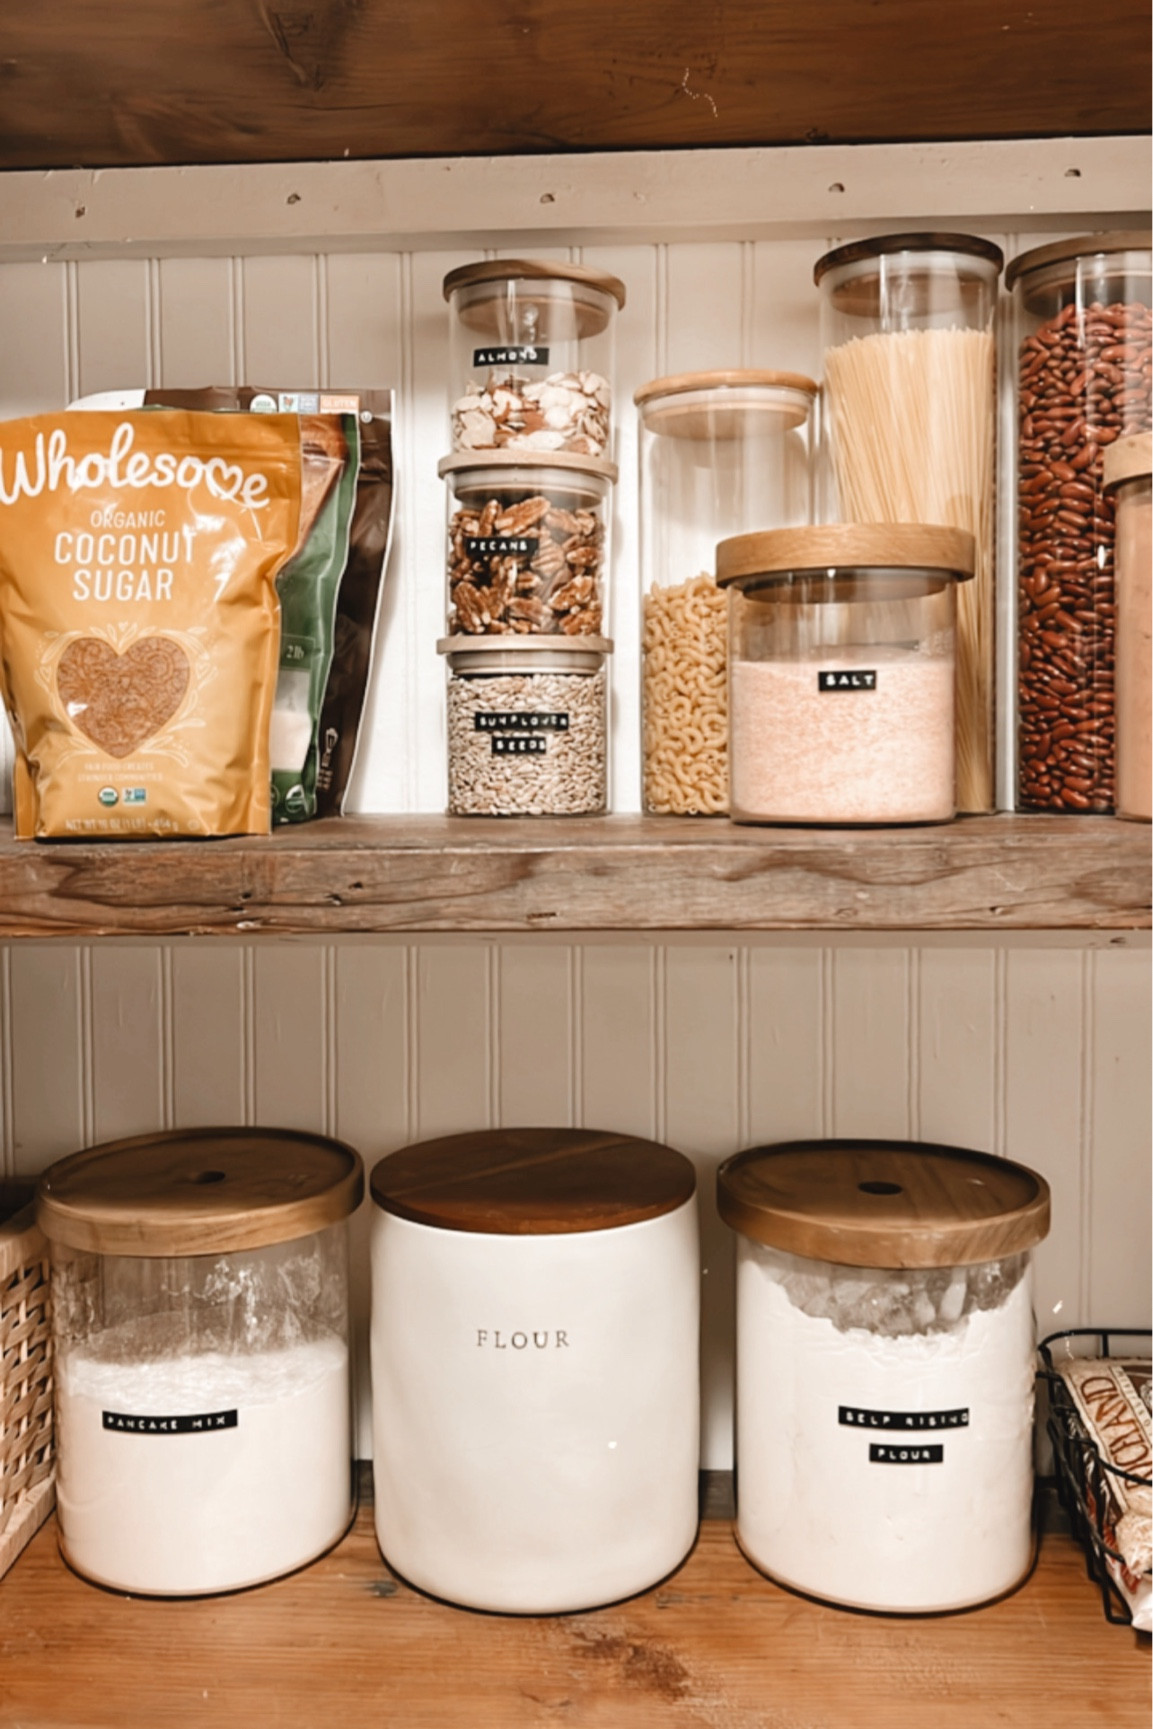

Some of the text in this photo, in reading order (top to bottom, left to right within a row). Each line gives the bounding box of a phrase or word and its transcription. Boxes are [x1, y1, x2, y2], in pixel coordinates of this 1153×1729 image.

[90, 509, 166, 529] ORGANIC
[54, 530, 196, 567] COCONUT
[470, 541, 528, 551] PECANS
[72, 569, 174, 601] SUGAR
[826, 674, 875, 686] SALT
[496, 740, 546, 751] SEEDS
[477, 1329, 570, 1350] FLOUR
[107, 1416, 226, 1430] PANCAKE MIX
[878, 1448, 931, 1461] FLOUR
